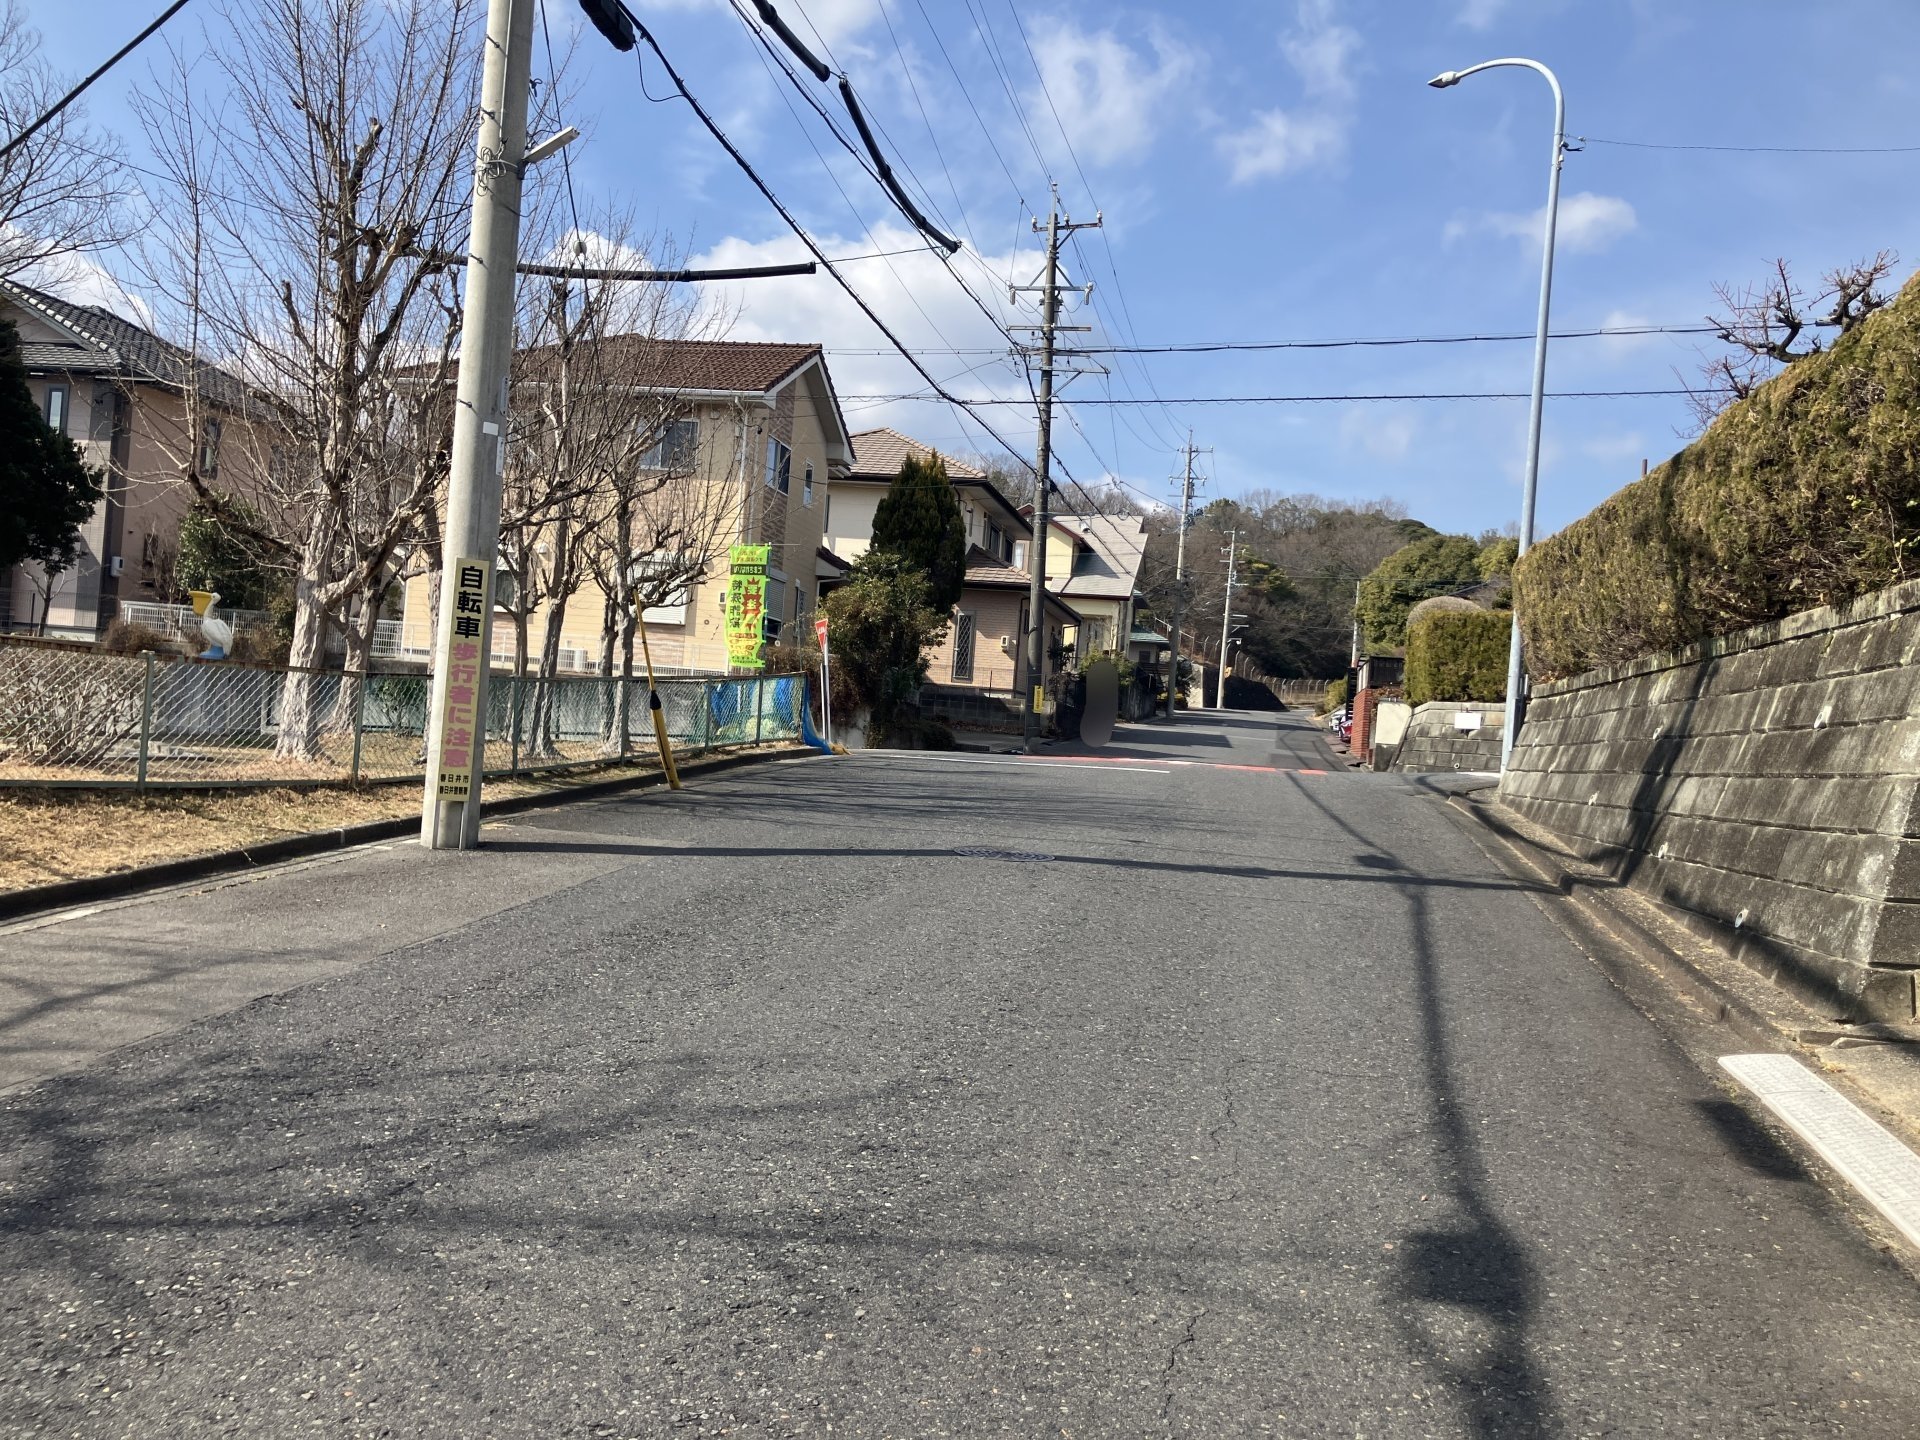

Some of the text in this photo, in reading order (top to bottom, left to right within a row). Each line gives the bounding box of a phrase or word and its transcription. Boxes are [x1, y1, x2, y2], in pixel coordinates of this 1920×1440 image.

[443, 566, 483, 767] 自転車 歩行者に注意
[440, 773, 470, 784] 春日井市
